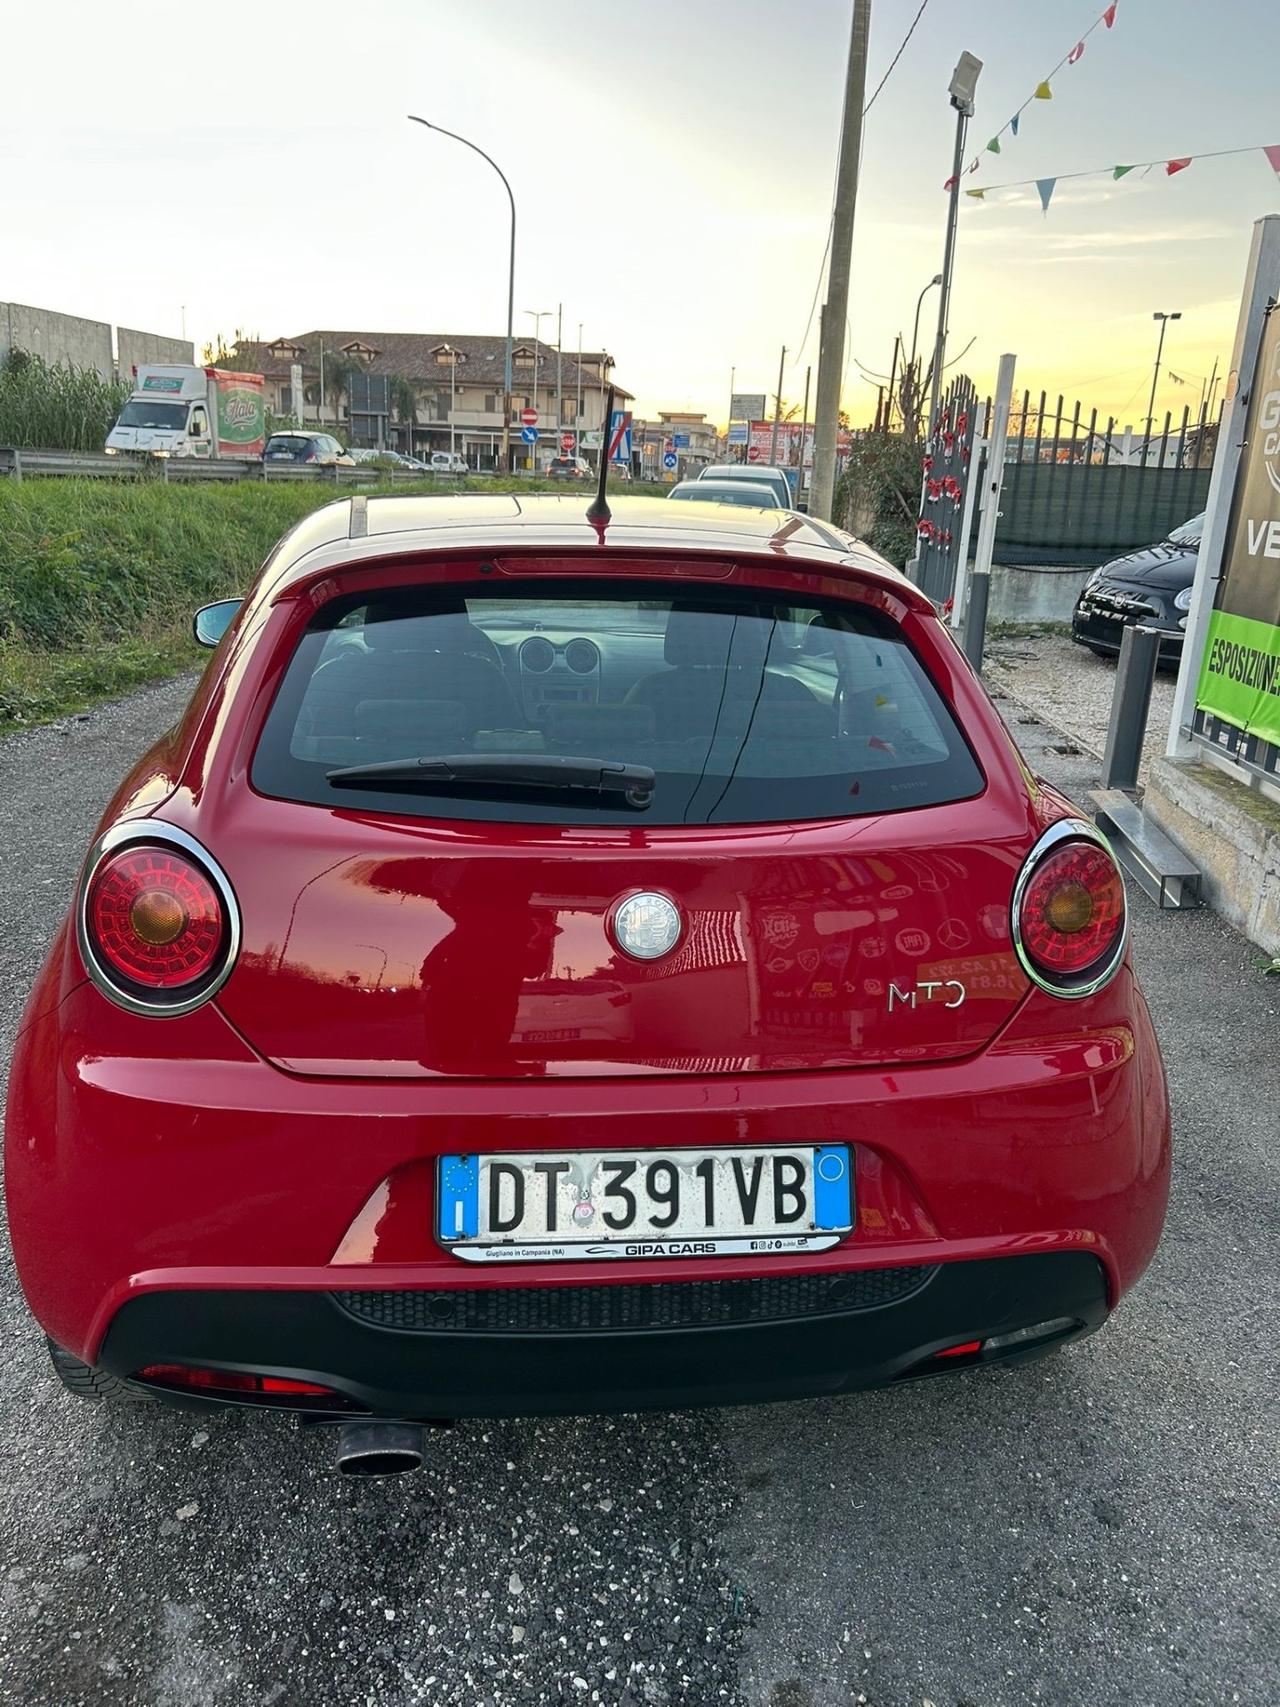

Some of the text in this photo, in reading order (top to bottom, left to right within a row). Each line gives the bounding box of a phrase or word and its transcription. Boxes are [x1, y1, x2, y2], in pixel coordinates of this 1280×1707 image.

[1260, 390, 1280, 430] G
[561, 438, 575, 446] STOP
[485, 1249, 514, 1258] Giugliano
[521, 1248, 551, 1257] Campania
[551, 1248, 565, 1256] (NA)
[625, 1243, 717, 1256] GIPA CARS
